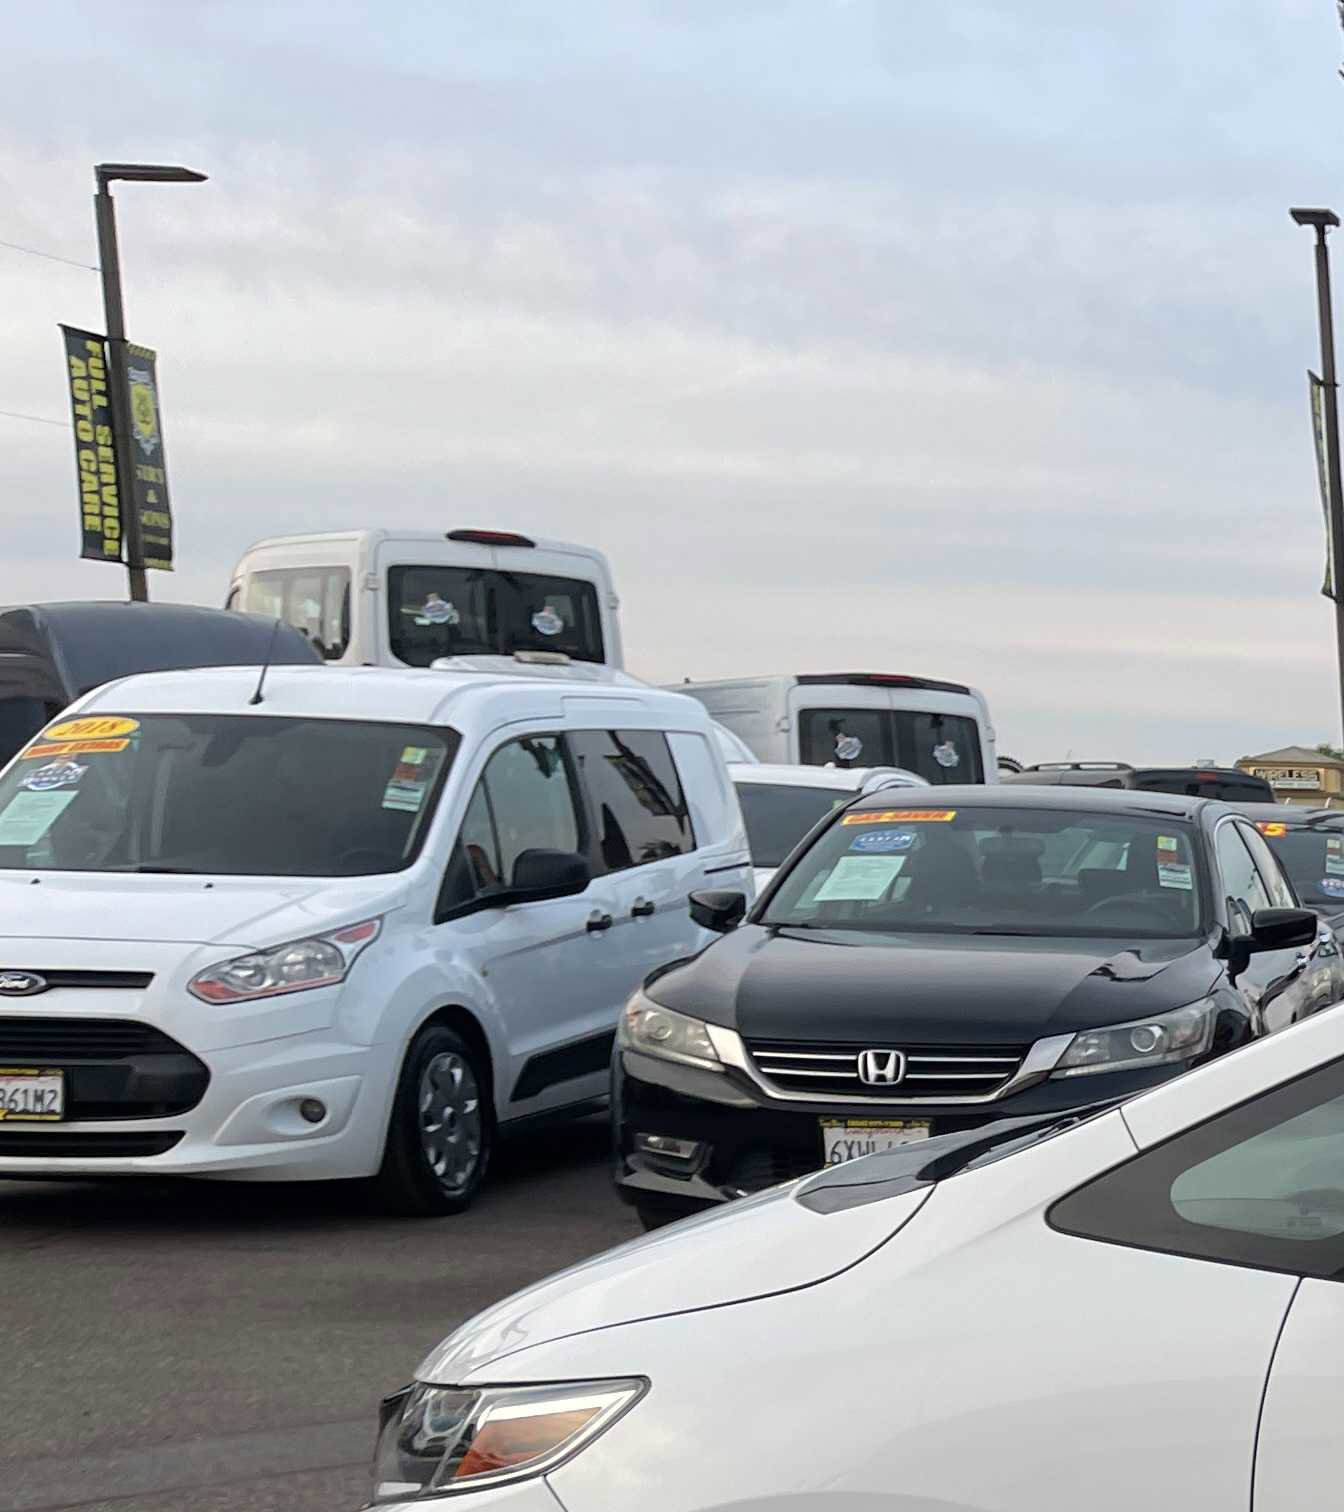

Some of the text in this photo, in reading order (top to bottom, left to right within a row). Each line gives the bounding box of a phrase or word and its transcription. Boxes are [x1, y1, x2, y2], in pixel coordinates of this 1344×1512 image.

[70, 355, 101, 532] AUTO CARE
[86, 340, 120, 556] FULL SERVICE
